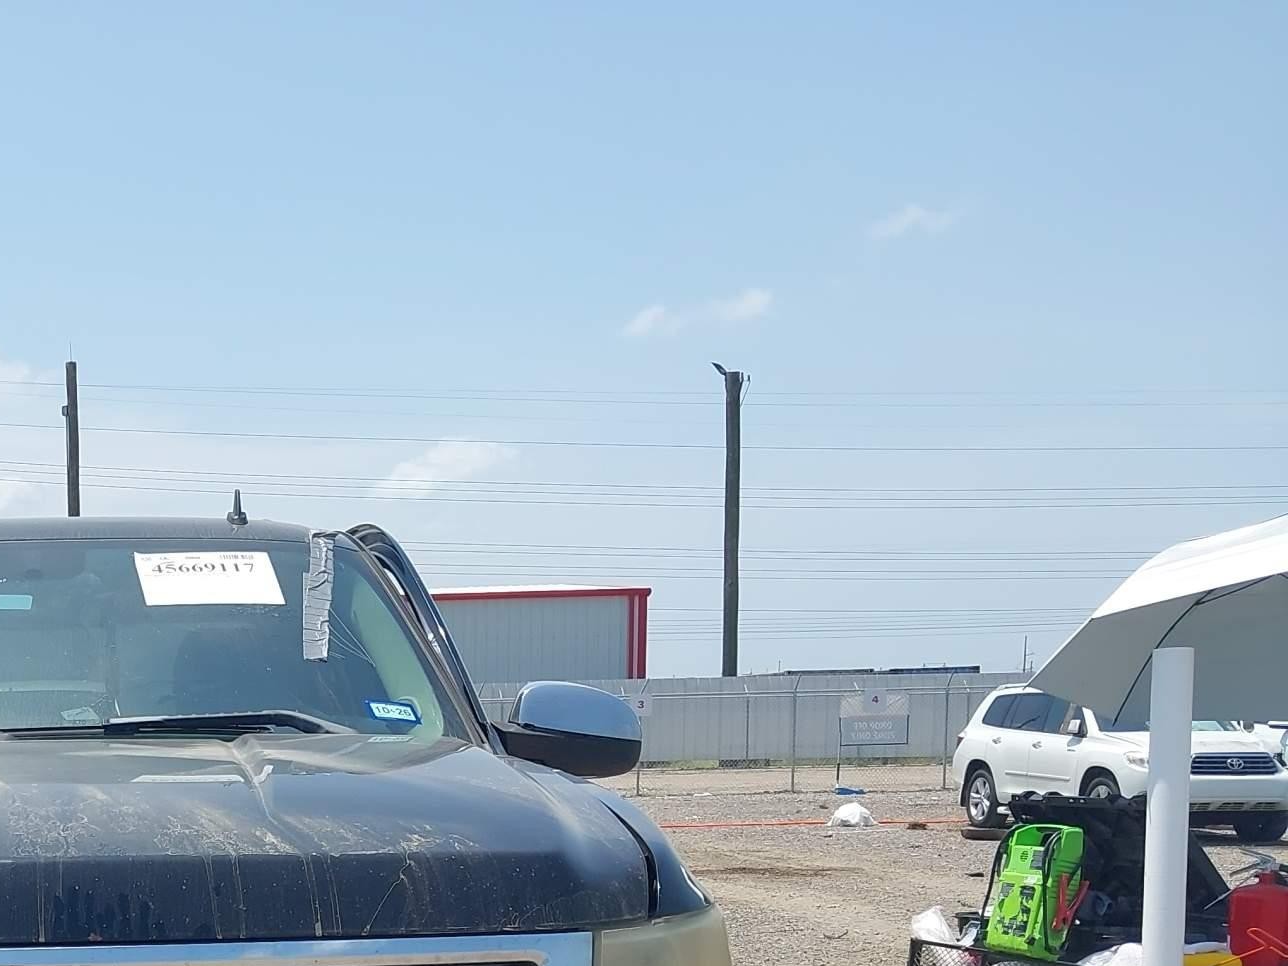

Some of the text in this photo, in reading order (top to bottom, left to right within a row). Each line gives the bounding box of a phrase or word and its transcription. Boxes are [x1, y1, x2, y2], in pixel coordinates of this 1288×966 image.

[151, 562, 254, 574] 45669117
[871, 695, 879, 704] 4
[637, 700, 645, 709] 3
